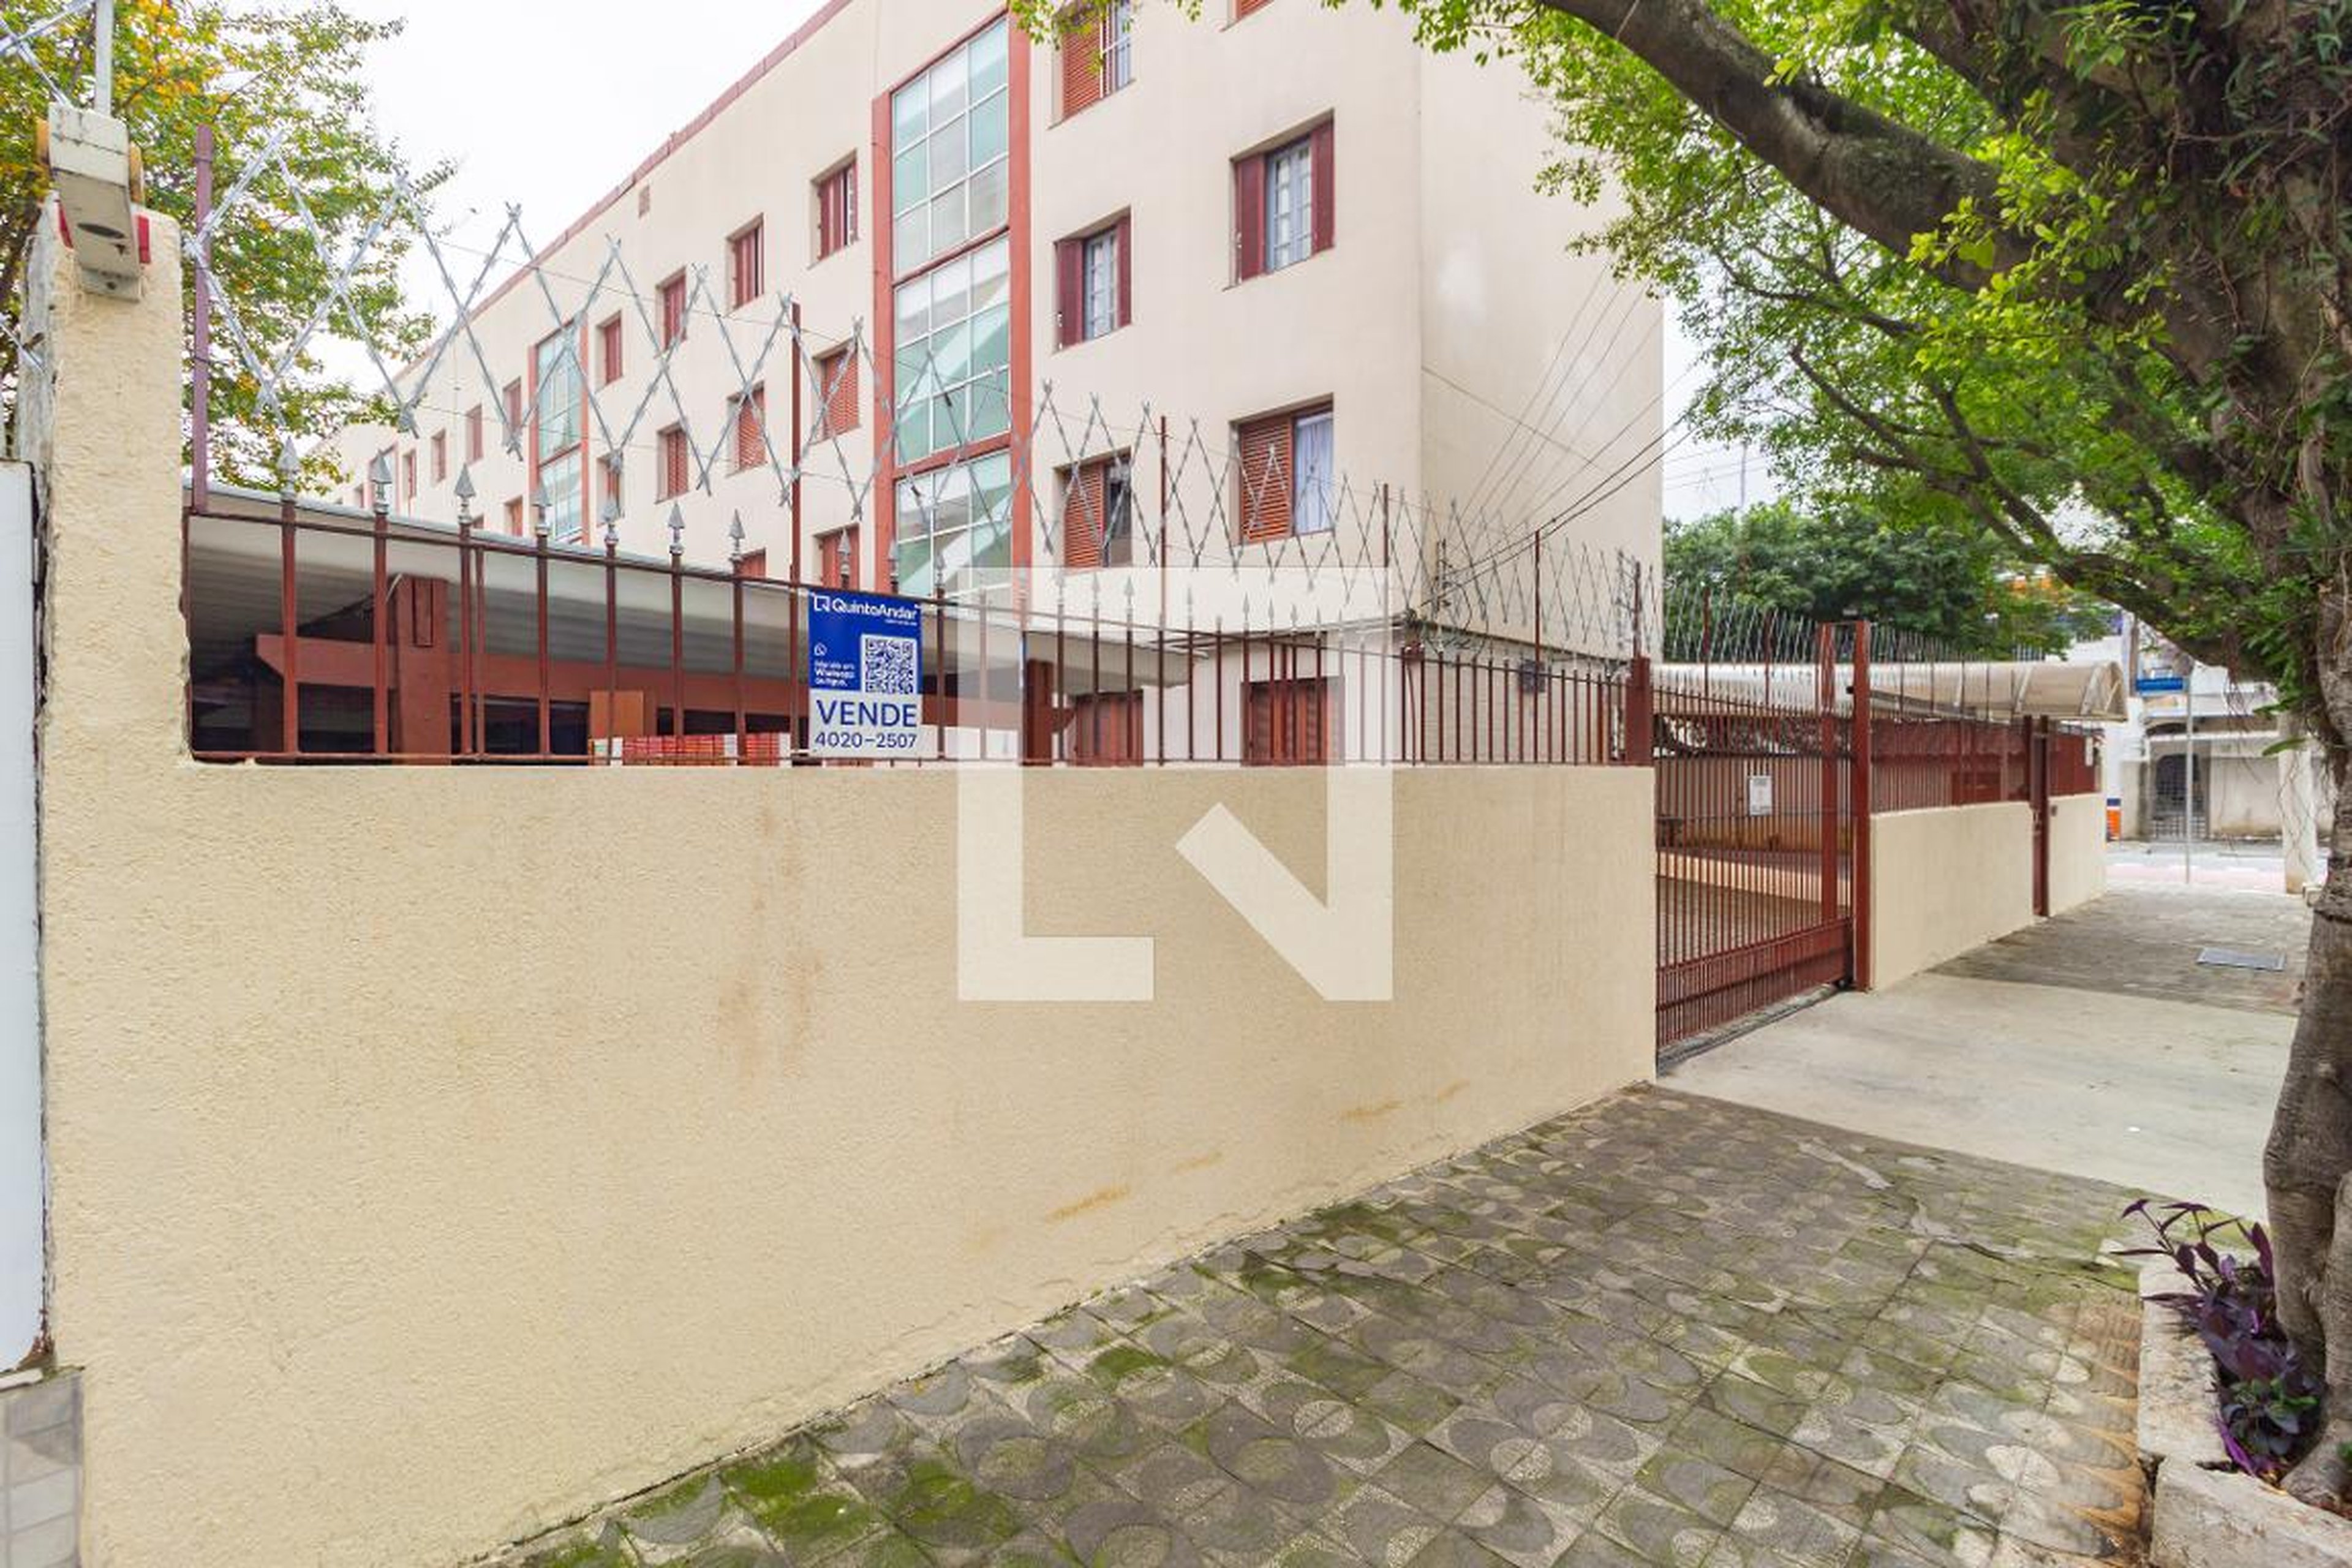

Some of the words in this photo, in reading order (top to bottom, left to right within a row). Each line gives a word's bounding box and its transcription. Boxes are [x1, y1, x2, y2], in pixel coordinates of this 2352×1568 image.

[832, 598, 917, 619] QuintoAndar
[816, 699, 918, 728] VENDE
[815, 731, 918, 749] 4020-2507
